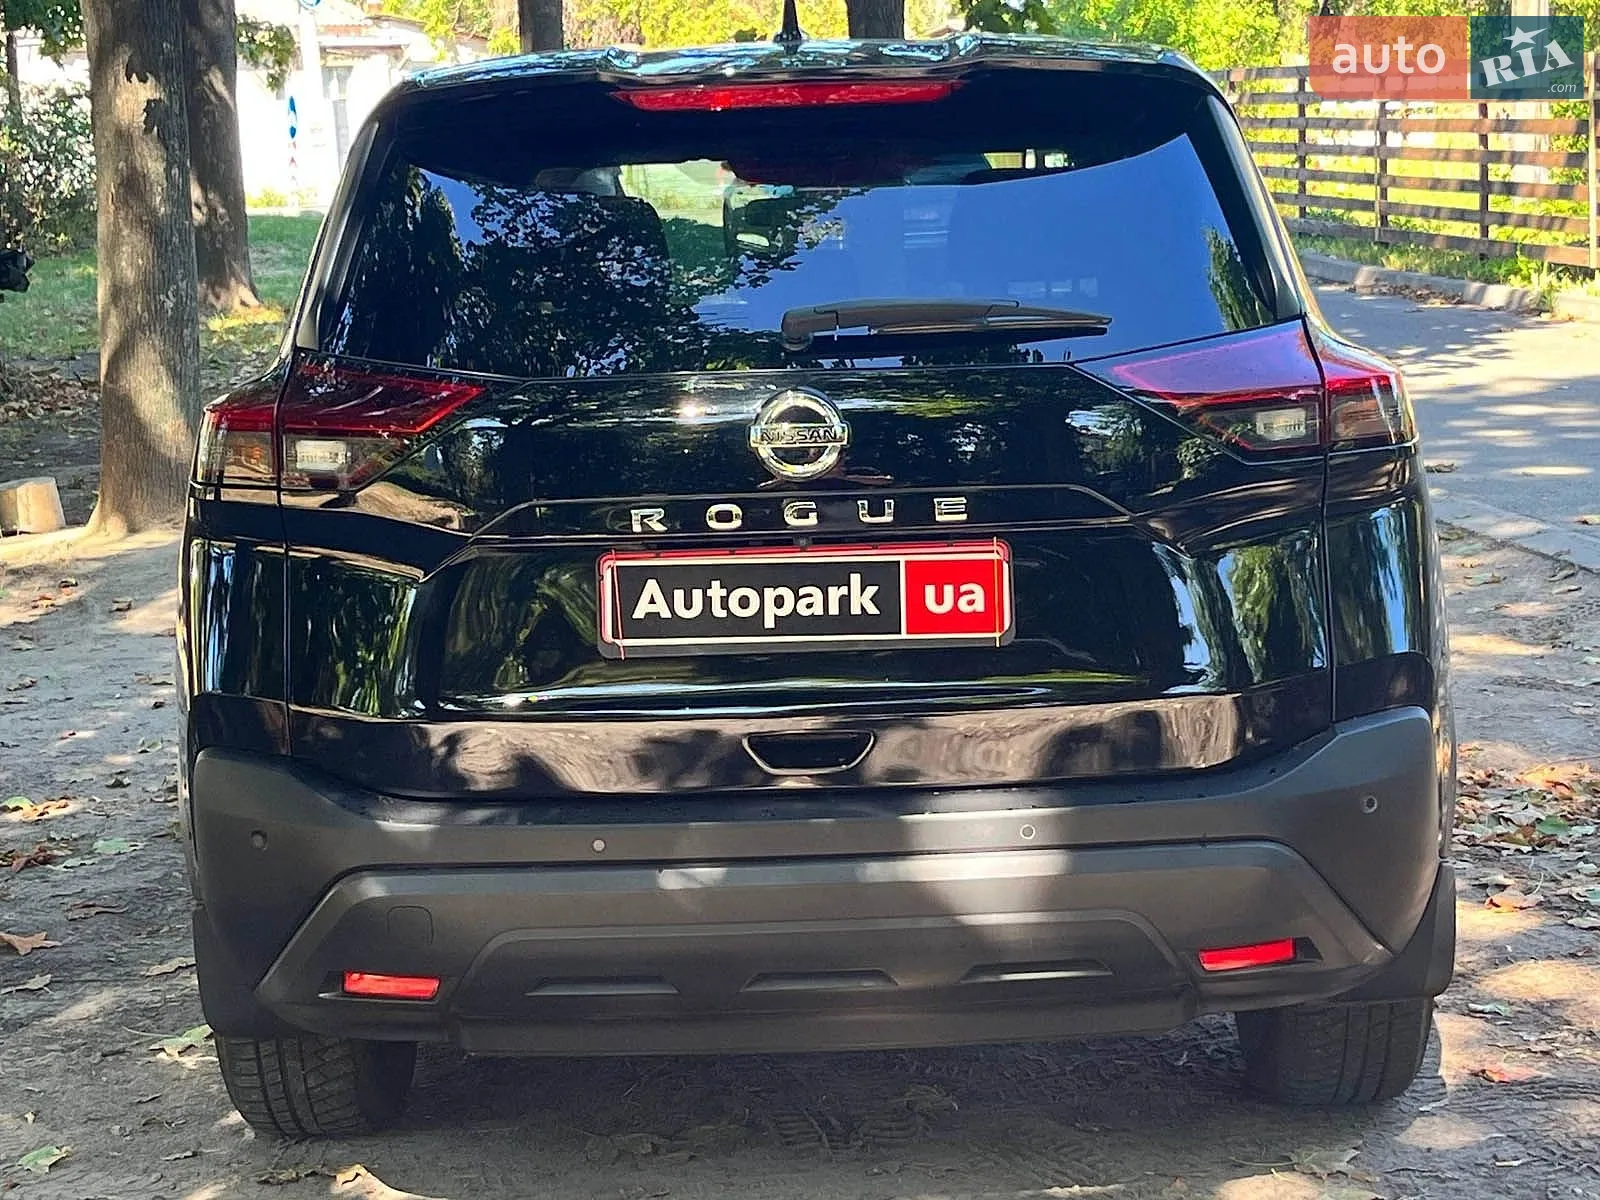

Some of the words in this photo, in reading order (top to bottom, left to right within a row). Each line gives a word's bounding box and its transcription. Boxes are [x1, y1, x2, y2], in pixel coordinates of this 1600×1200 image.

[760, 427, 837, 442] NISSAN
[631, 497, 968, 533] ROGUE
[632, 573, 880, 629] Autopark
[924, 583, 985, 614] ua
